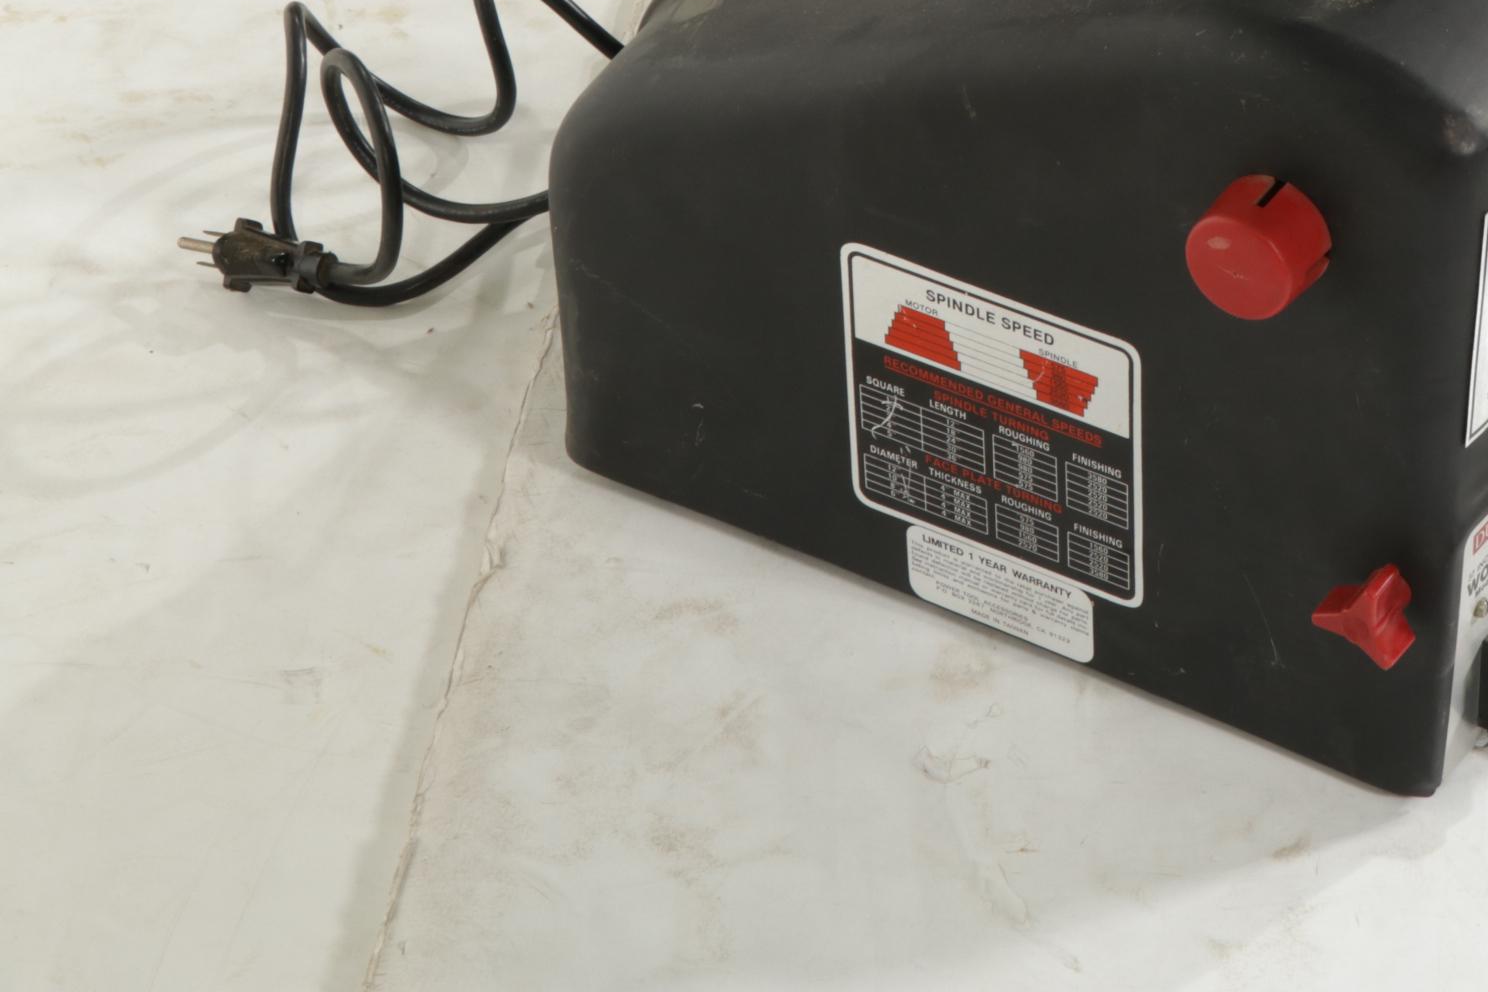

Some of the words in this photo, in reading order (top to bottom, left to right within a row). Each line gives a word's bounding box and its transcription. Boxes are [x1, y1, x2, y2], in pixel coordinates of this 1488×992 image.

[905, 298, 938, 316] MOTOR
[925, 288, 994, 324] SPINDLE
[1001, 315, 1054, 346] SPEED
[1038, 347, 1077, 368] SPINDLE
[865, 374, 904, 397] SQUARE
[884, 354, 985, 402] RECOMMENDED
[987, 392, 1046, 425] GENERAL
[1052, 417, 1102, 447] SPEEDS
[929, 398, 966, 420] LENGTH
[933, 389, 986, 418] SPINDLE
[992, 411, 1049, 441] TURNING
[998, 425, 1049, 451] ROUGHING
[869, 444, 917, 469] DIAMETER
[1072, 452, 1121, 479] FINISHING
[924, 454, 957, 474] FACE
[960, 468, 1002, 491] PLATE
[1007, 485, 1062, 514] TURNING
[928, 466, 981, 494] THICKNESS
[1001, 494, 1051, 521] ROUGHING
[1073, 522, 1122, 549] FINISHING
[922, 533, 964, 557] LIMITED
[969, 551, 972, 560] 1
[979, 555, 1006, 573] YEAR
[1013, 568, 1071, 599] WARRANTY
